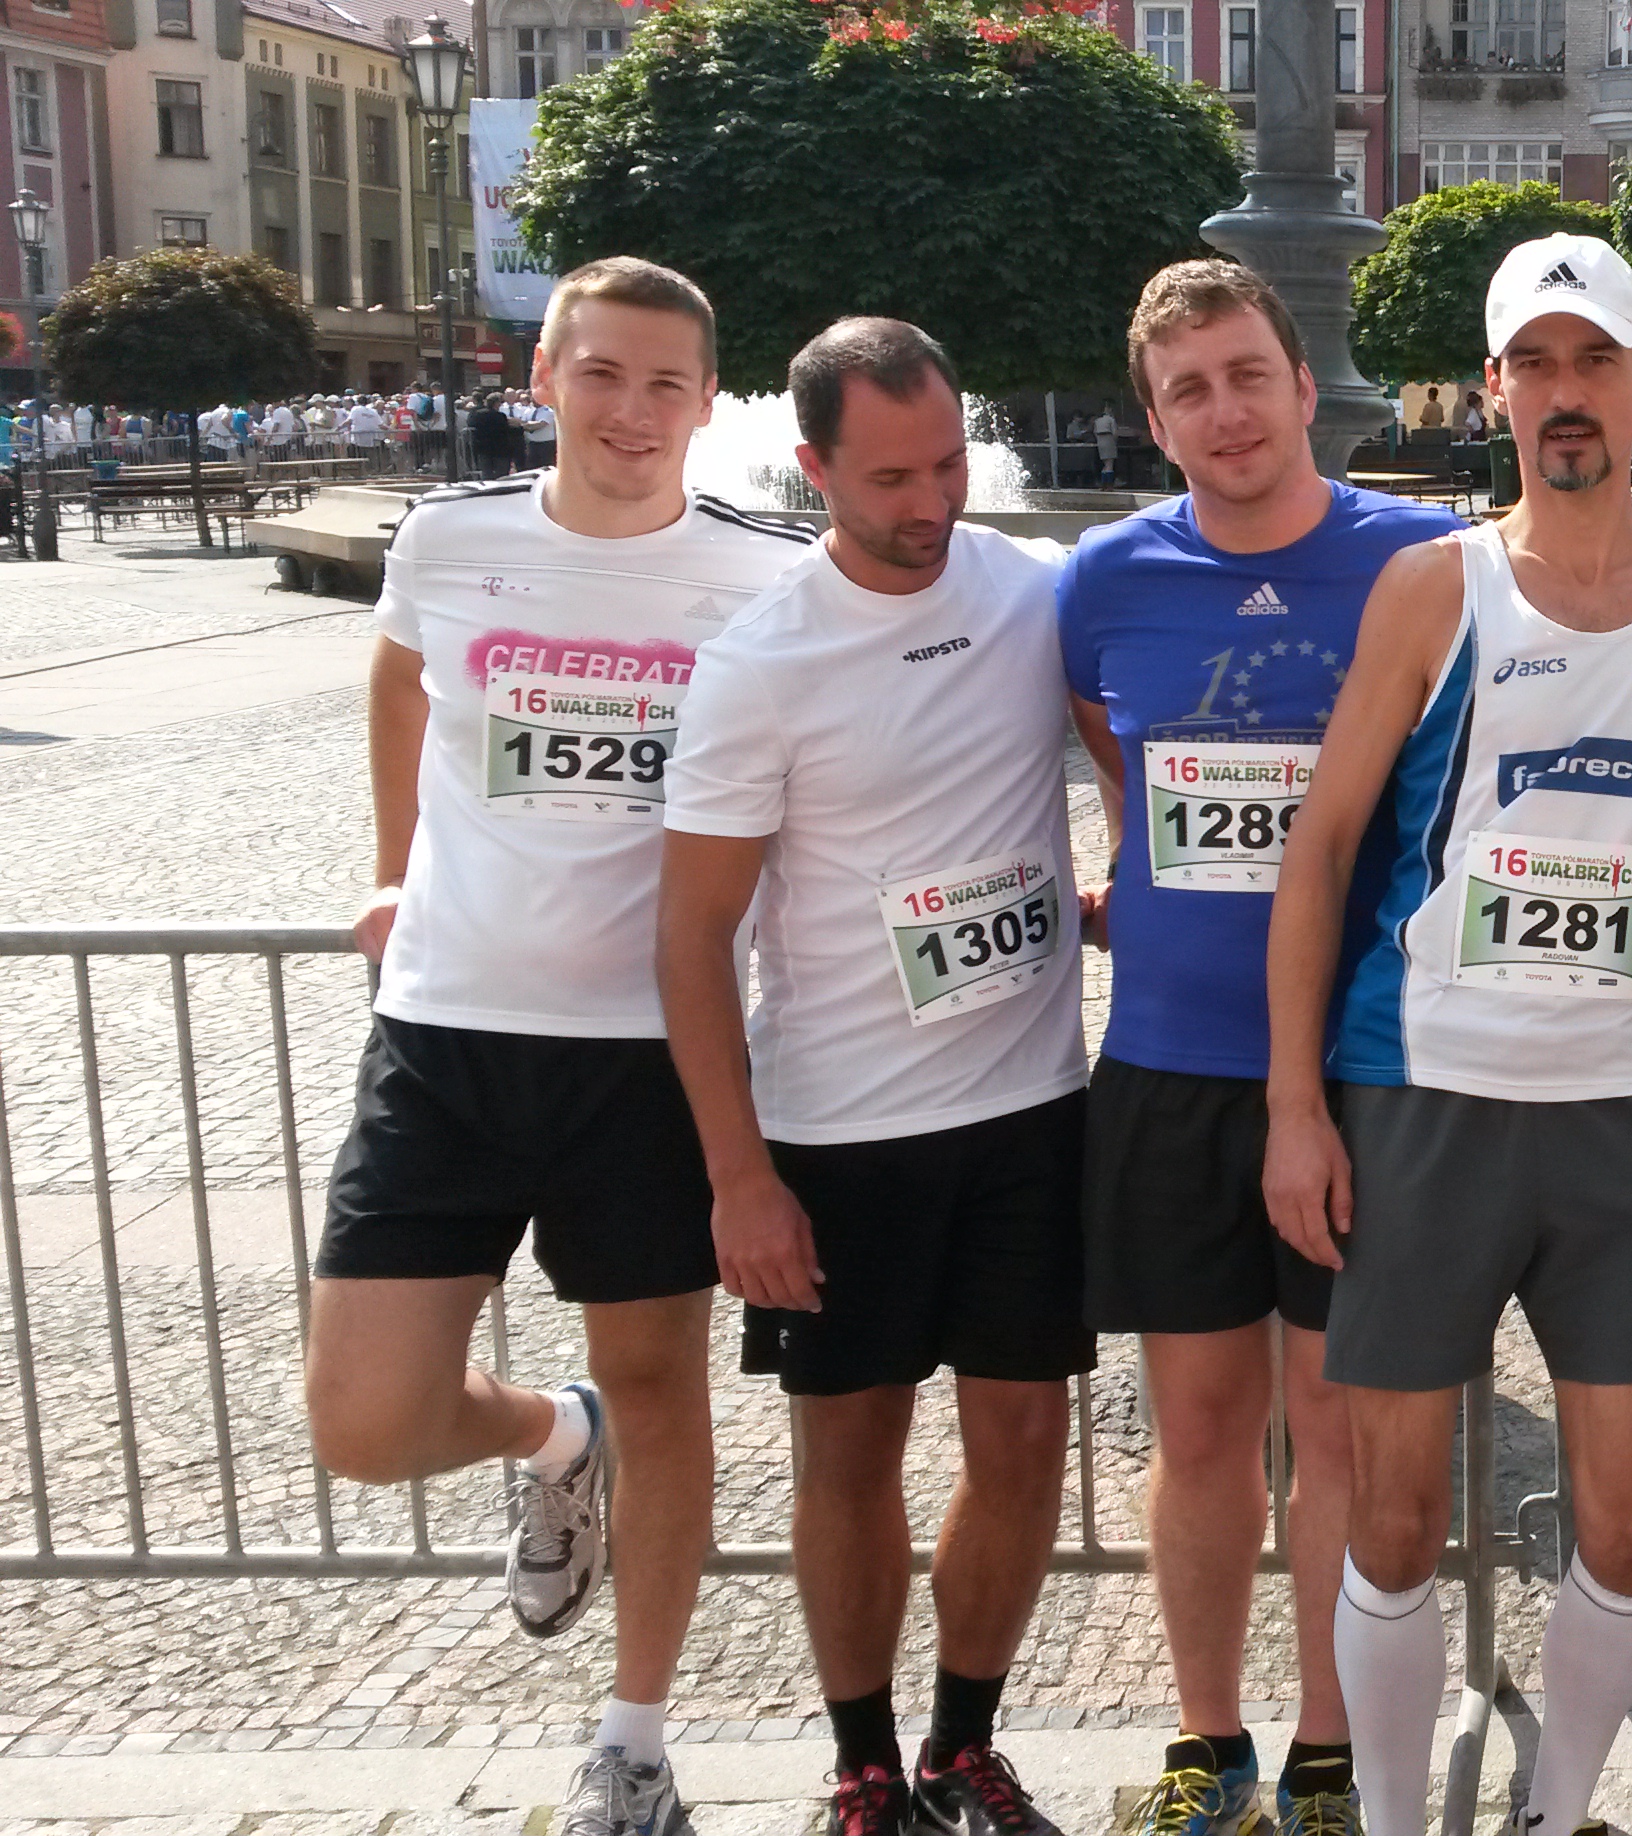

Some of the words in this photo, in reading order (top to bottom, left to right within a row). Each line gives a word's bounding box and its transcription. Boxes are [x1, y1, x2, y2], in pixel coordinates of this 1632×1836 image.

[1534, 280, 1588, 293] adidas
[1236, 603, 1289, 616] adidas
[1517, 657, 1567, 678] asics
[508, 686, 548, 714] 16
[504, 732, 667, 783] 1529
[1163, 756, 1200, 783] 16
[1489, 847, 1528, 877] 16
[903, 886, 945, 917] 16
[916, 898, 1048, 977] 1305
[1481, 895, 1630, 954] 1281
[1541, 952, 1579, 962] RADOVAN
